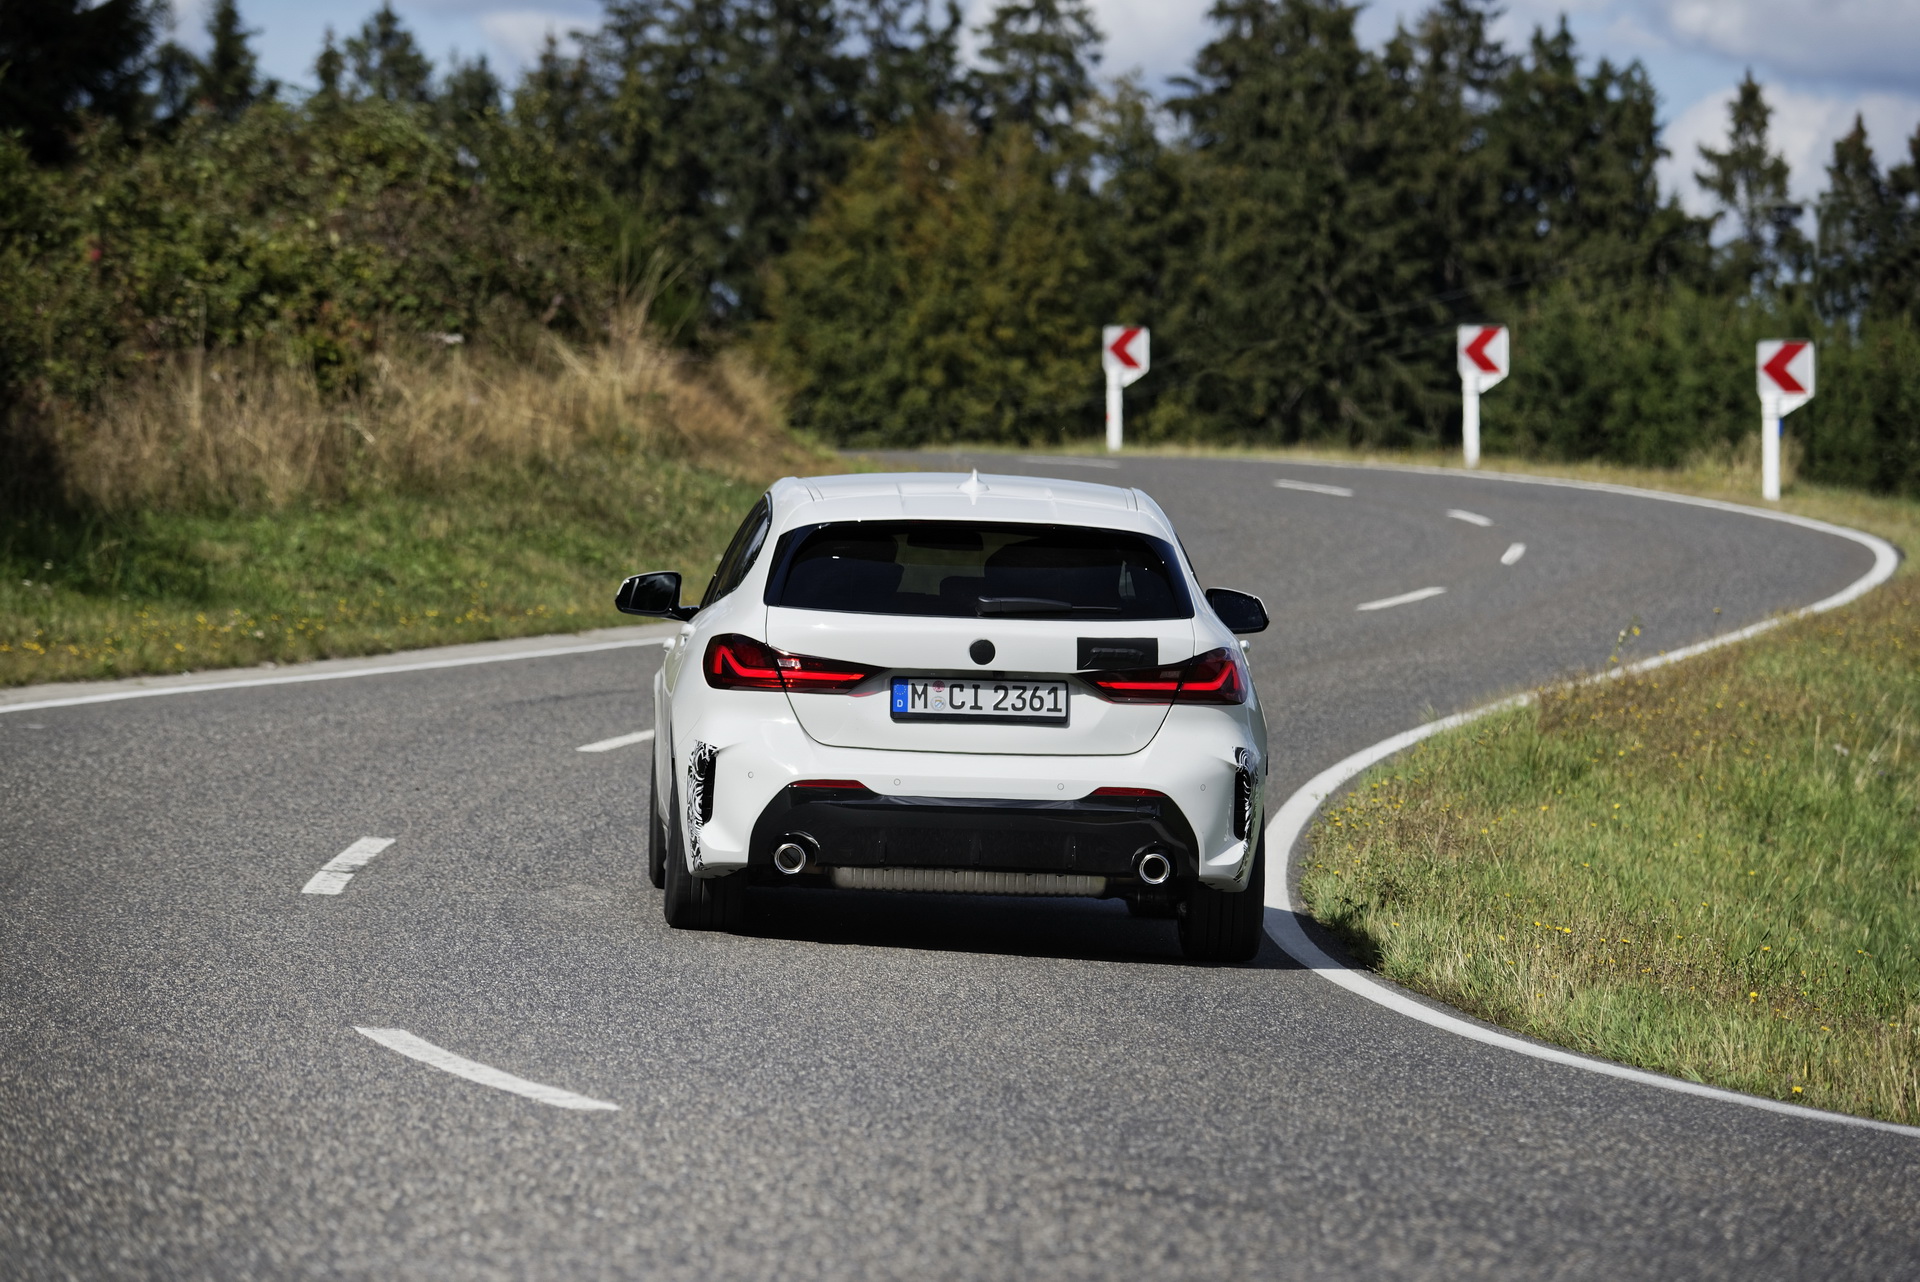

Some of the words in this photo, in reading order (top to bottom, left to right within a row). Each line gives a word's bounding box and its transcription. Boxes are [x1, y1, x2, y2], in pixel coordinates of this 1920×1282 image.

[896, 699, 903, 707] D
[911, 683, 928, 709] M
[949, 683, 983, 710] CI
[993, 685, 1063, 712] 2361
